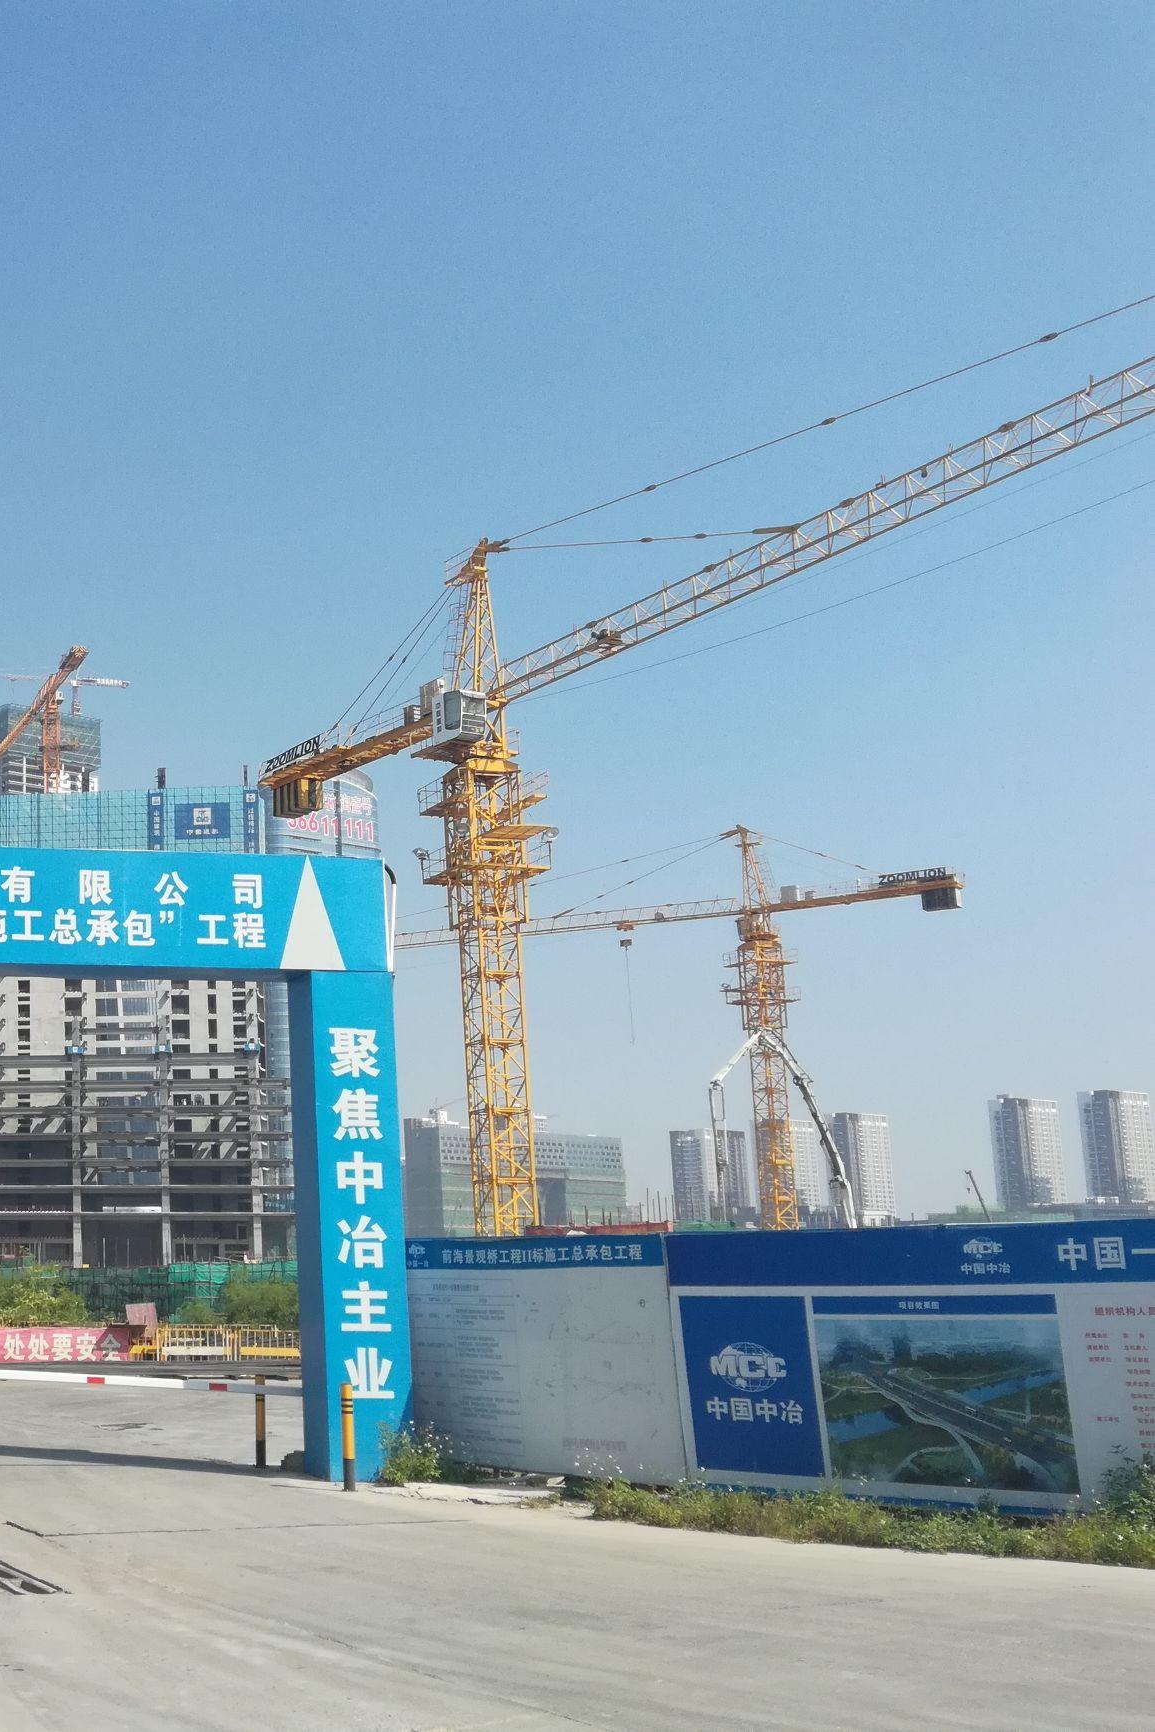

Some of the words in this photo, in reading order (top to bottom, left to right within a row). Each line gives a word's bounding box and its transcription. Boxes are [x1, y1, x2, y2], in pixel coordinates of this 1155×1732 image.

[266, 735, 321, 772] ZOOMLION
[878, 867, 946, 886] ZOOMLION
[328, 1027, 395, 1400] 聚焦中冶主业
[441, 1243, 644, 1265] 前海景观桥工程II标施工总承包工程
[962, 1241, 1003, 1254] MCC
[960, 1262, 1011, 1275] 中国中冶
[710, 1354, 787, 1378] MCC
[706, 1396, 804, 1425] 中国中冶
